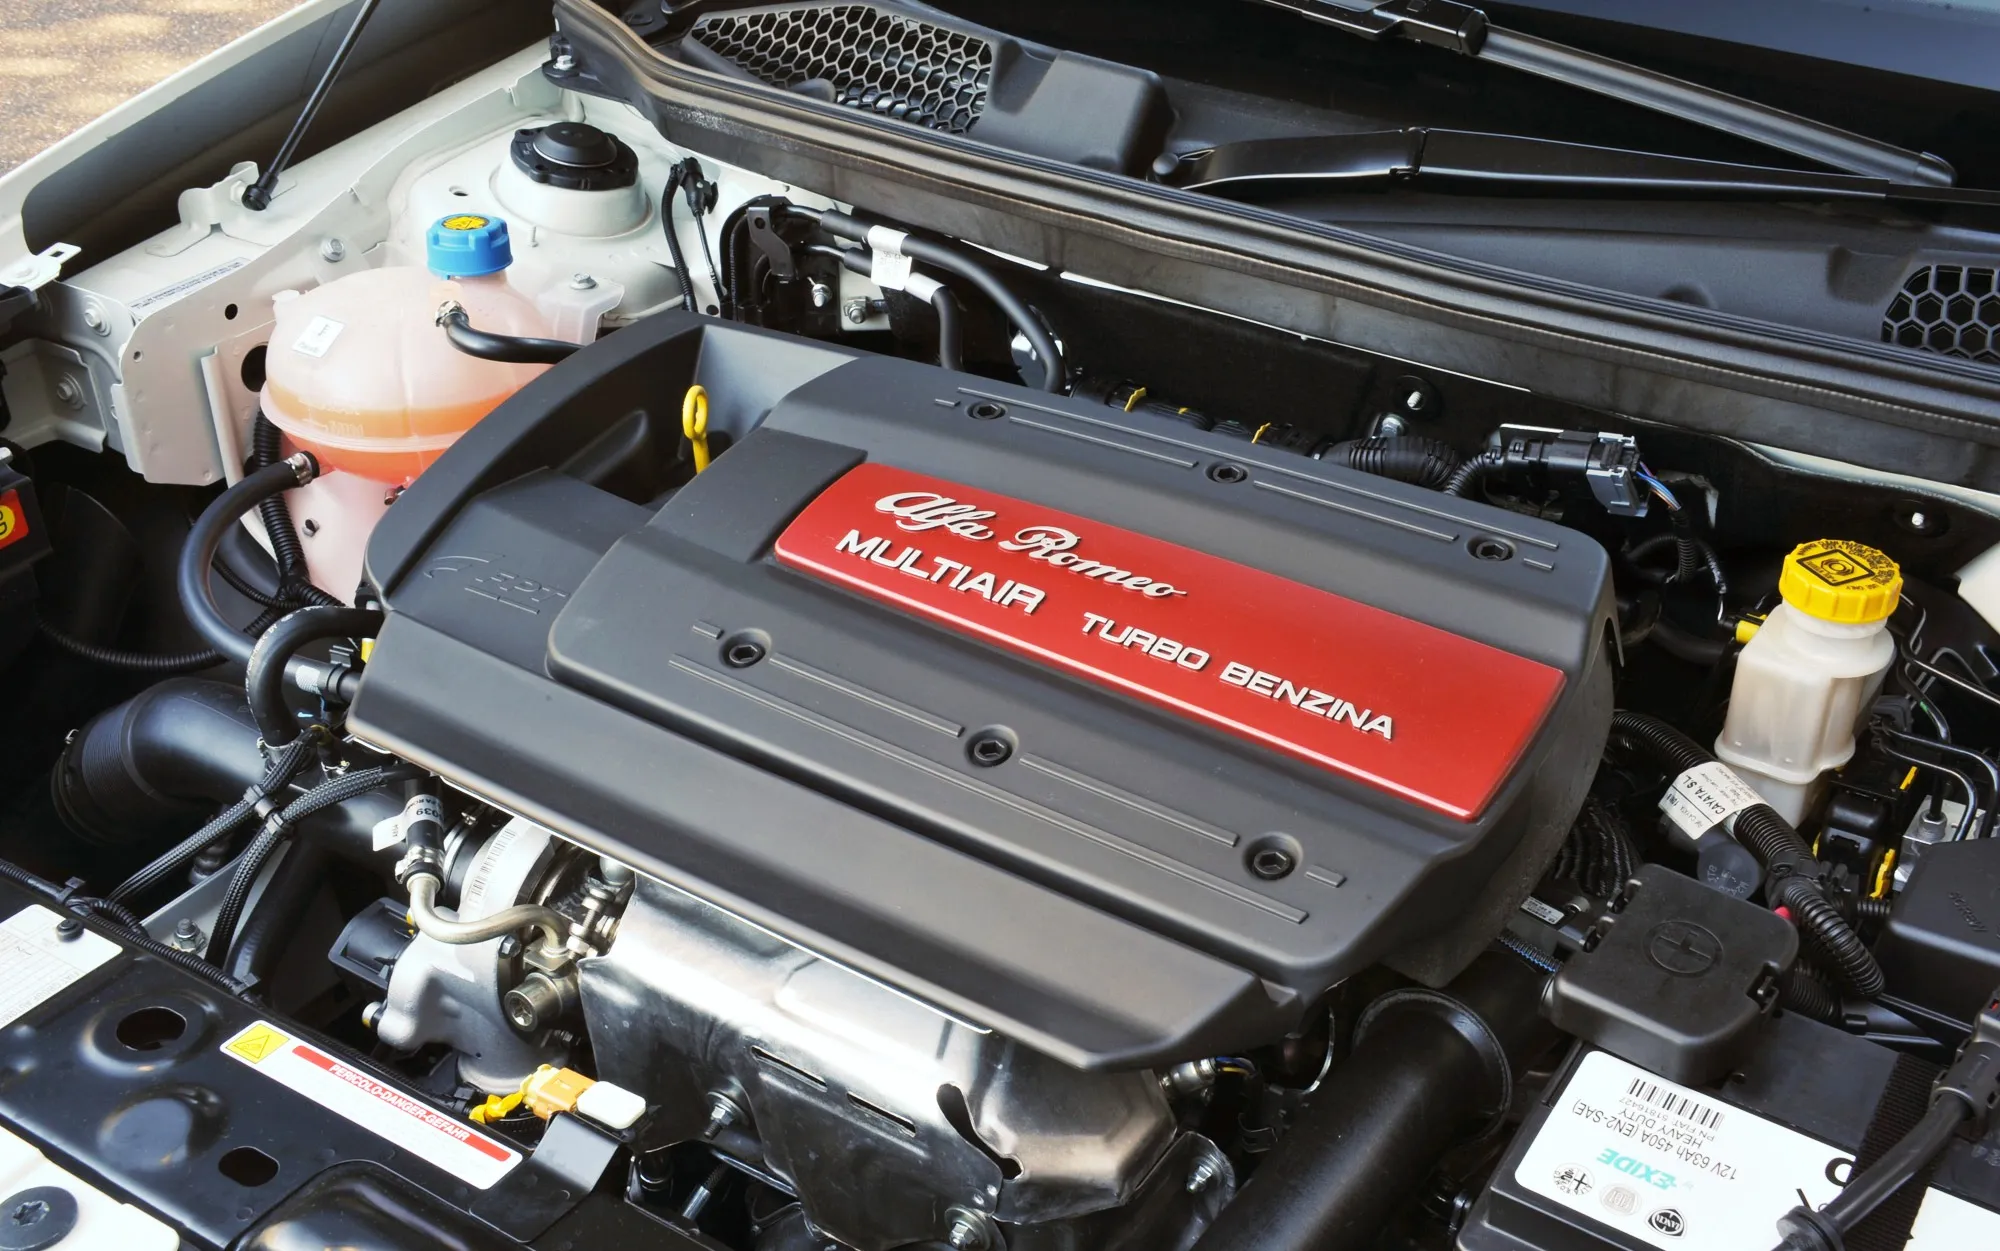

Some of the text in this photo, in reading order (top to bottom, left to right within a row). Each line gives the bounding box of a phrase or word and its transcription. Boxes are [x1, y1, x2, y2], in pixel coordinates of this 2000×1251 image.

[834, 529, 1047, 615] MULTIAIR
[875, 491, 1188, 598] Alfa Romeo
[1082, 611, 1394, 741] TURBO BENZINA
[328, 1063, 471, 1142] PERICOLO-DANGER-GEFAHR
[1571, 1098, 1738, 1181] 12V 63Ah 450A (EN2-SAE)
[1618, 1107, 1704, 1149] HEAVY DUTY
[1698, 1130, 1715, 1142] PN
[1596, 1148, 1678, 1190] EXIDE
